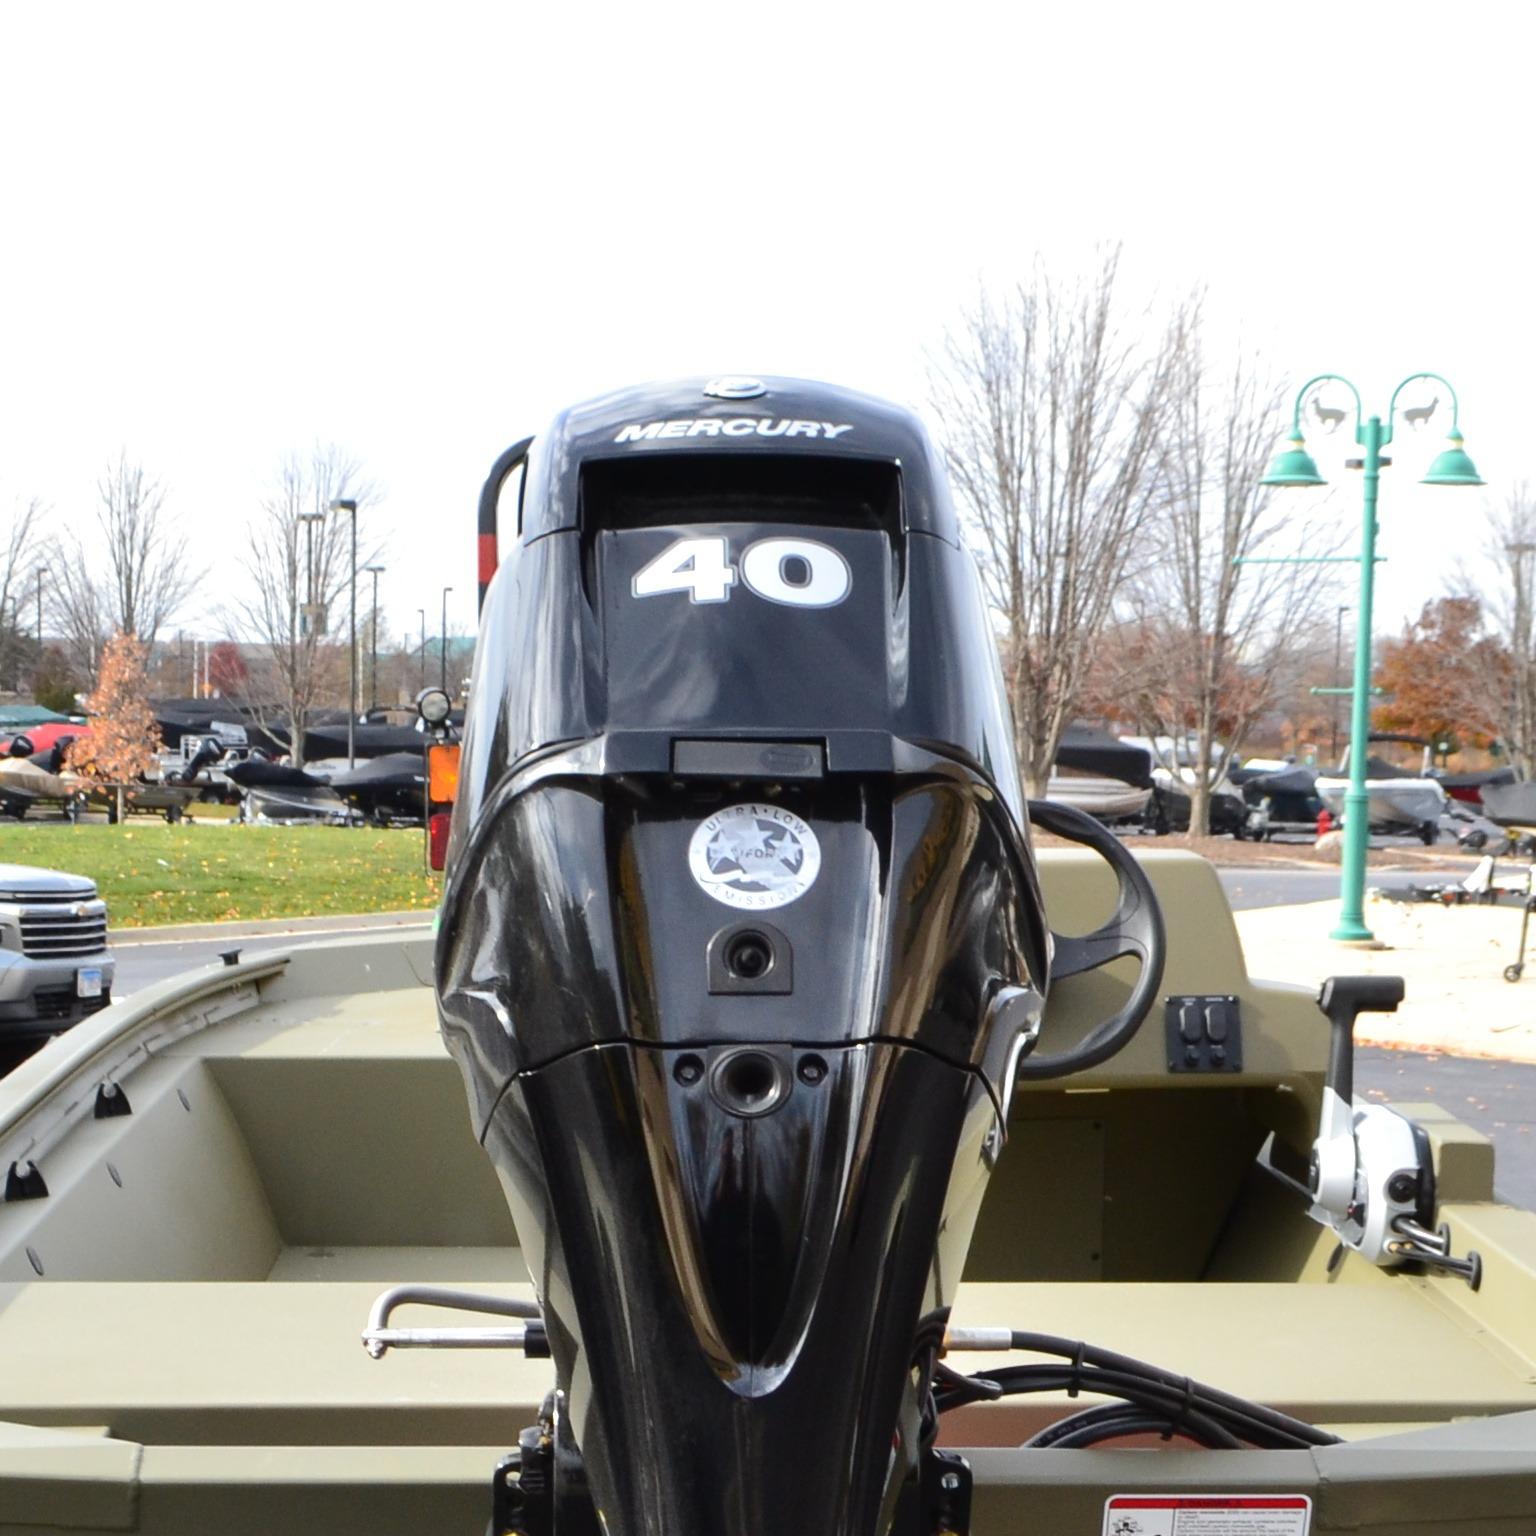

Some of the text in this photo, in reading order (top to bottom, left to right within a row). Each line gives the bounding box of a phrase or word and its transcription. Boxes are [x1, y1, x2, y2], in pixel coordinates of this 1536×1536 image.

[614, 418, 854, 443] MERCURY
[631, 536, 853, 609] 40
[772, 809, 808, 835] LOW
